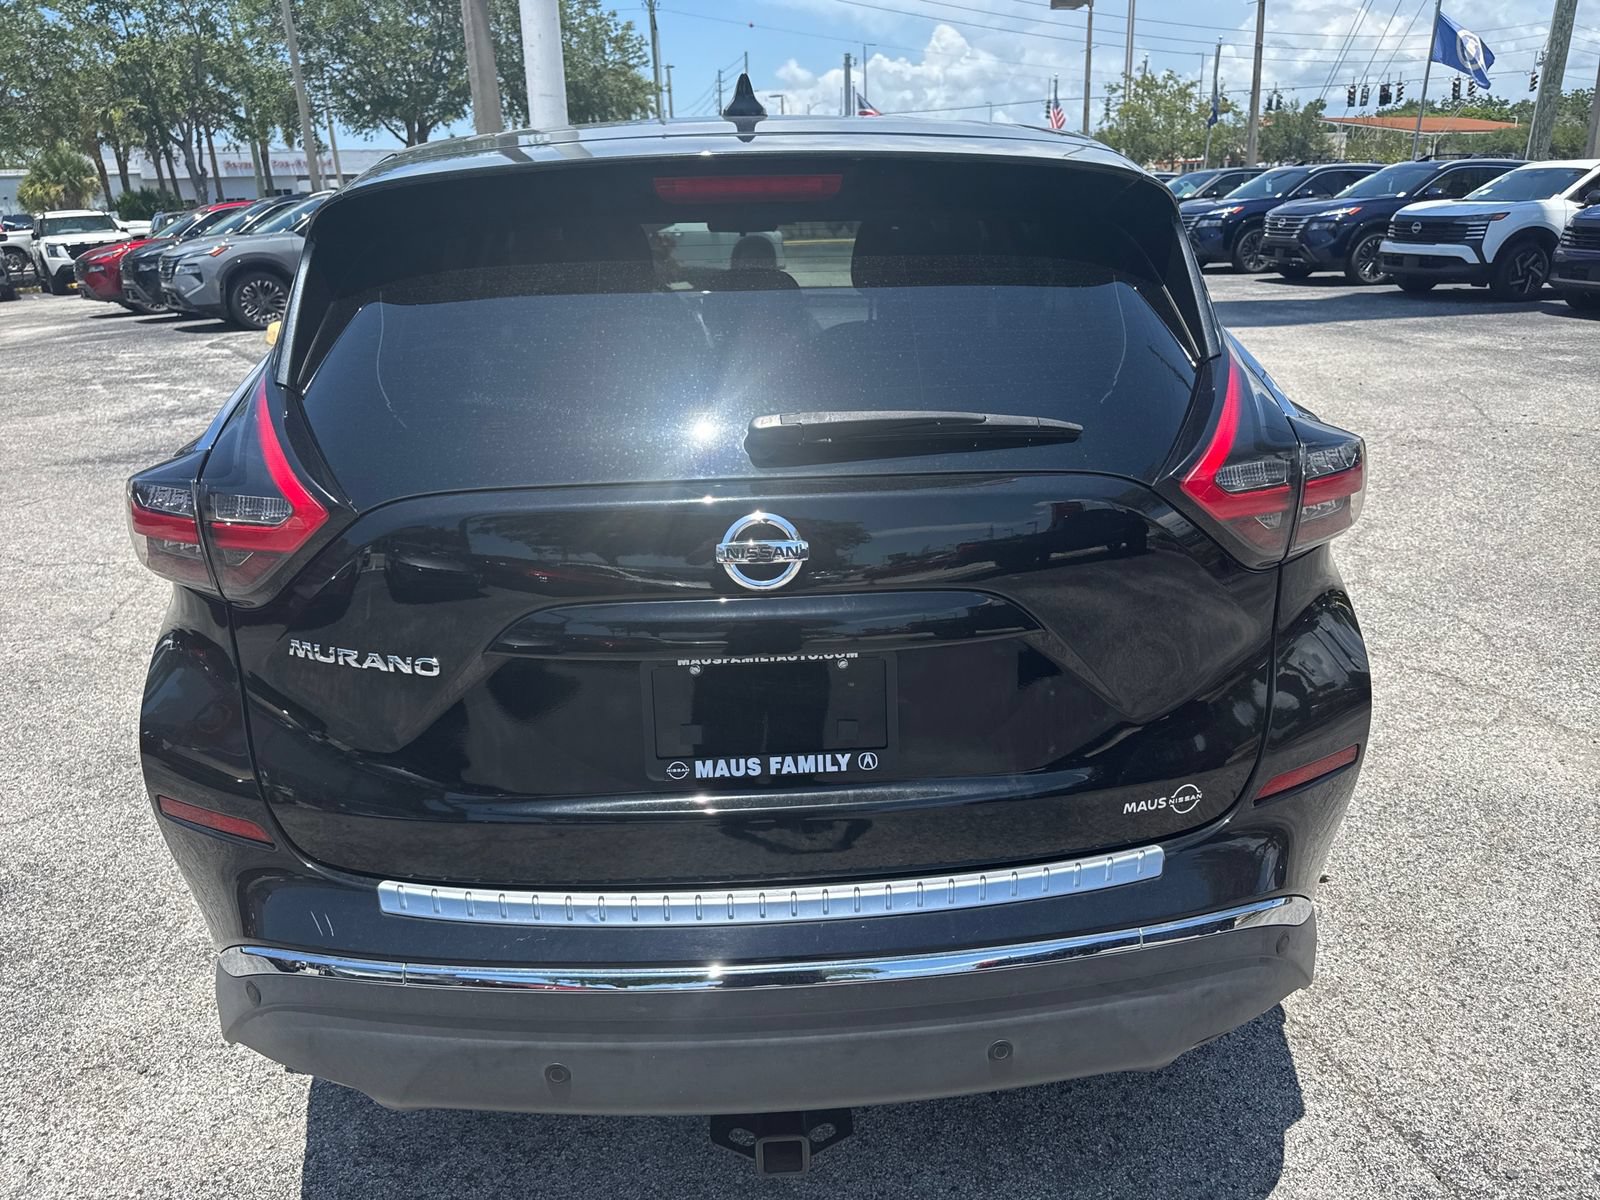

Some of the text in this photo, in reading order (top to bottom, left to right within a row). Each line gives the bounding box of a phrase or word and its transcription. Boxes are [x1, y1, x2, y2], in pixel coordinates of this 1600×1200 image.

[726, 546, 799, 560] NISSAN
[289, 639, 440, 677] MURANO
[694, 753, 851, 779] MAUS FAMILY
[1122, 793, 1203, 814] MAUS NISSAN
